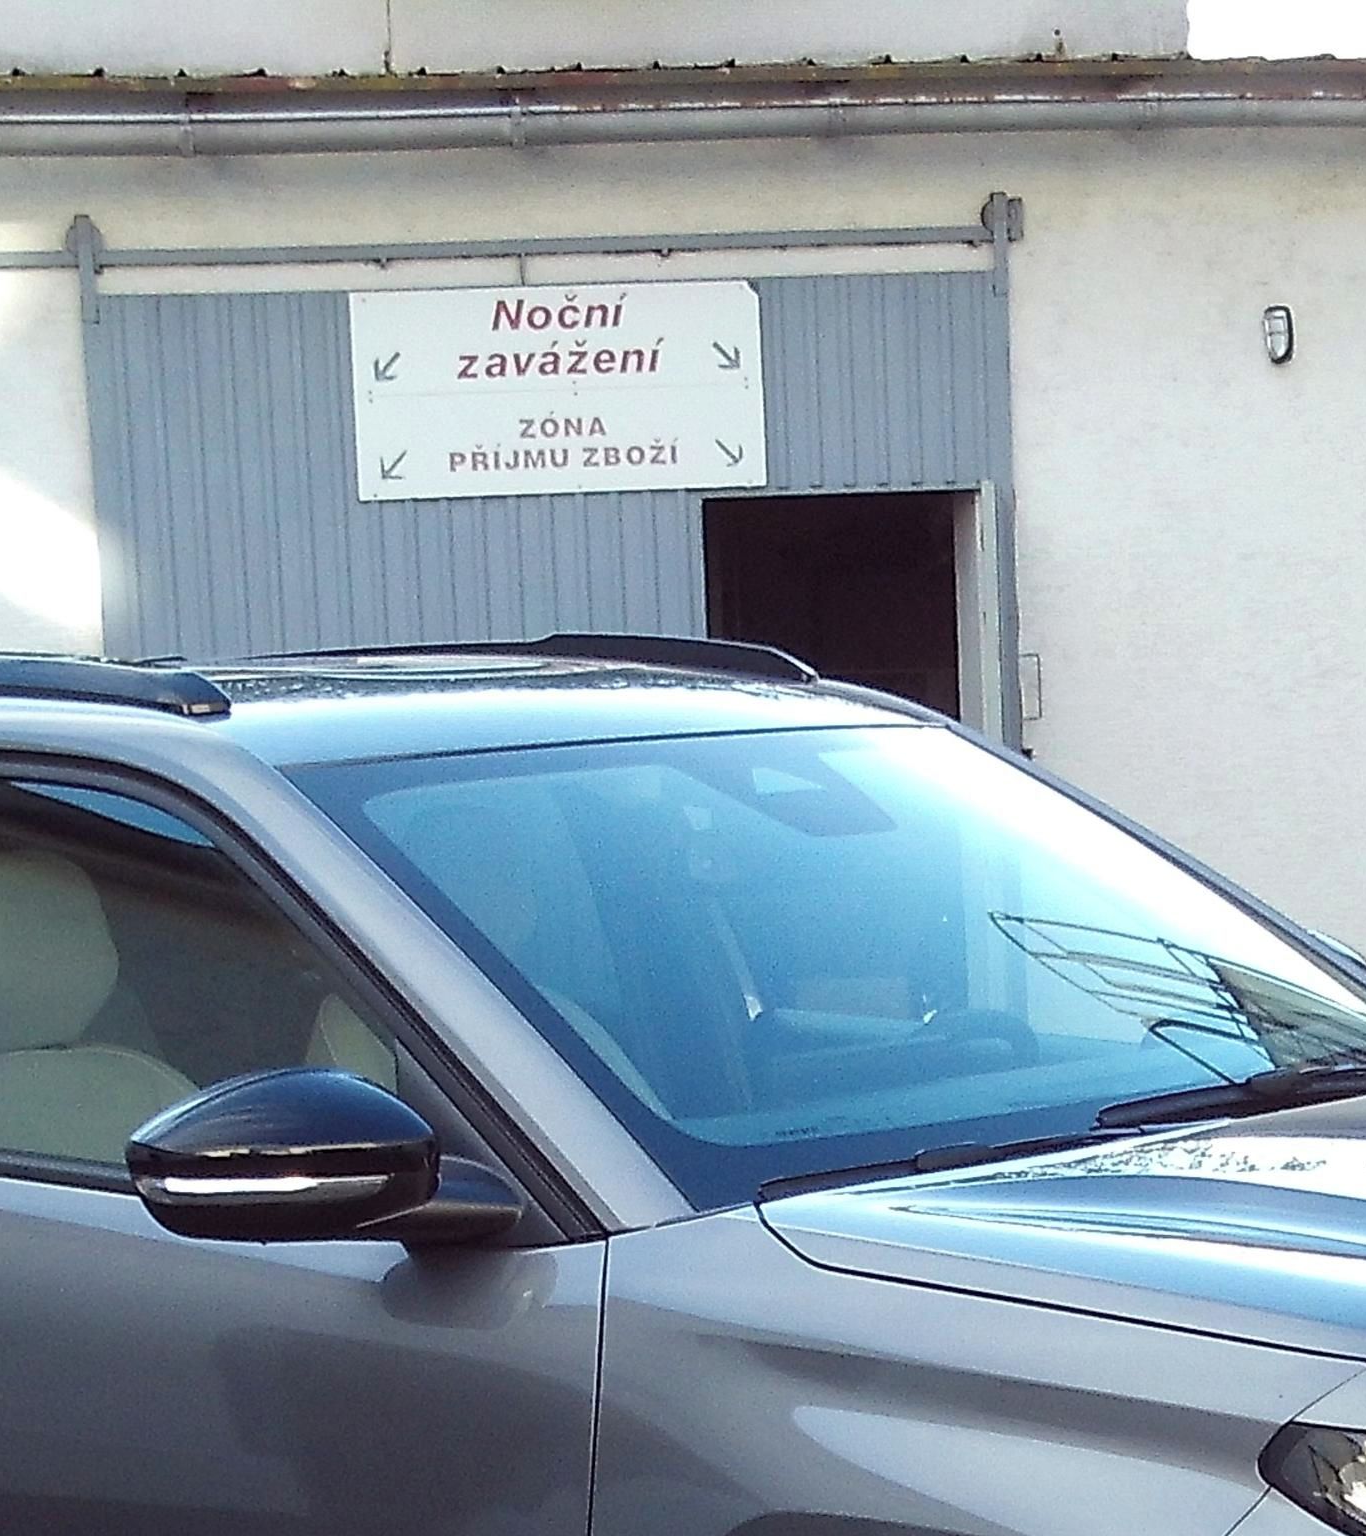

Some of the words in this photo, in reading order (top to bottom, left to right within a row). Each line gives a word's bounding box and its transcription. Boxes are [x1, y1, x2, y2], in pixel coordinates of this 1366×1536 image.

[491, 293, 627, 331] Noční
[457, 337, 664, 380] zavážení
[519, 411, 607, 438] ZÓNA
[448, 443, 570, 473] PŘÍJMU
[582, 438, 680, 468] ZBOŽÍ
